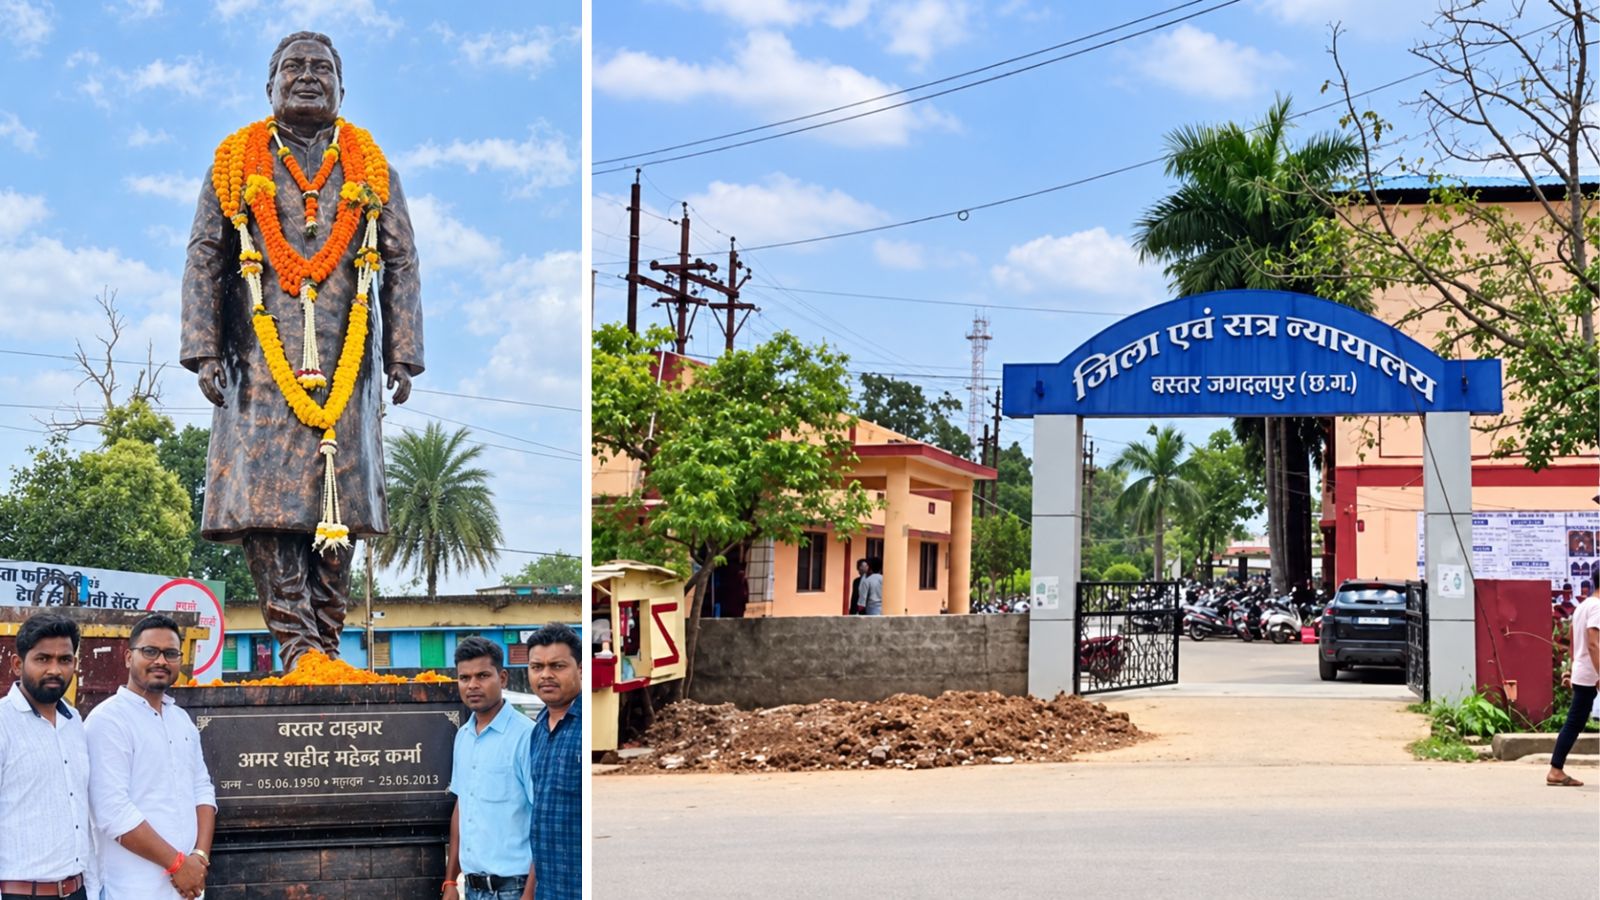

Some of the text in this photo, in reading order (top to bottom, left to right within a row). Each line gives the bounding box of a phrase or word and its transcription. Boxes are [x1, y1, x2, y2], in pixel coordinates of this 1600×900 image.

[1072, 307, 1438, 403] जिला एवं सत्र न्यायालय
[1151, 371, 1358, 400] बस्तर जगदलपुर (छ.ग.)
[329, 720, 383, 739] टाइगर
[238, 743, 422, 768] अमर शहीद महेन्द्र कर्मा
[220, 780, 242, 790] जन्म
[257, 777, 320, 789] 05.06.1950
[379, 774, 439, 786] 25.05.2013
